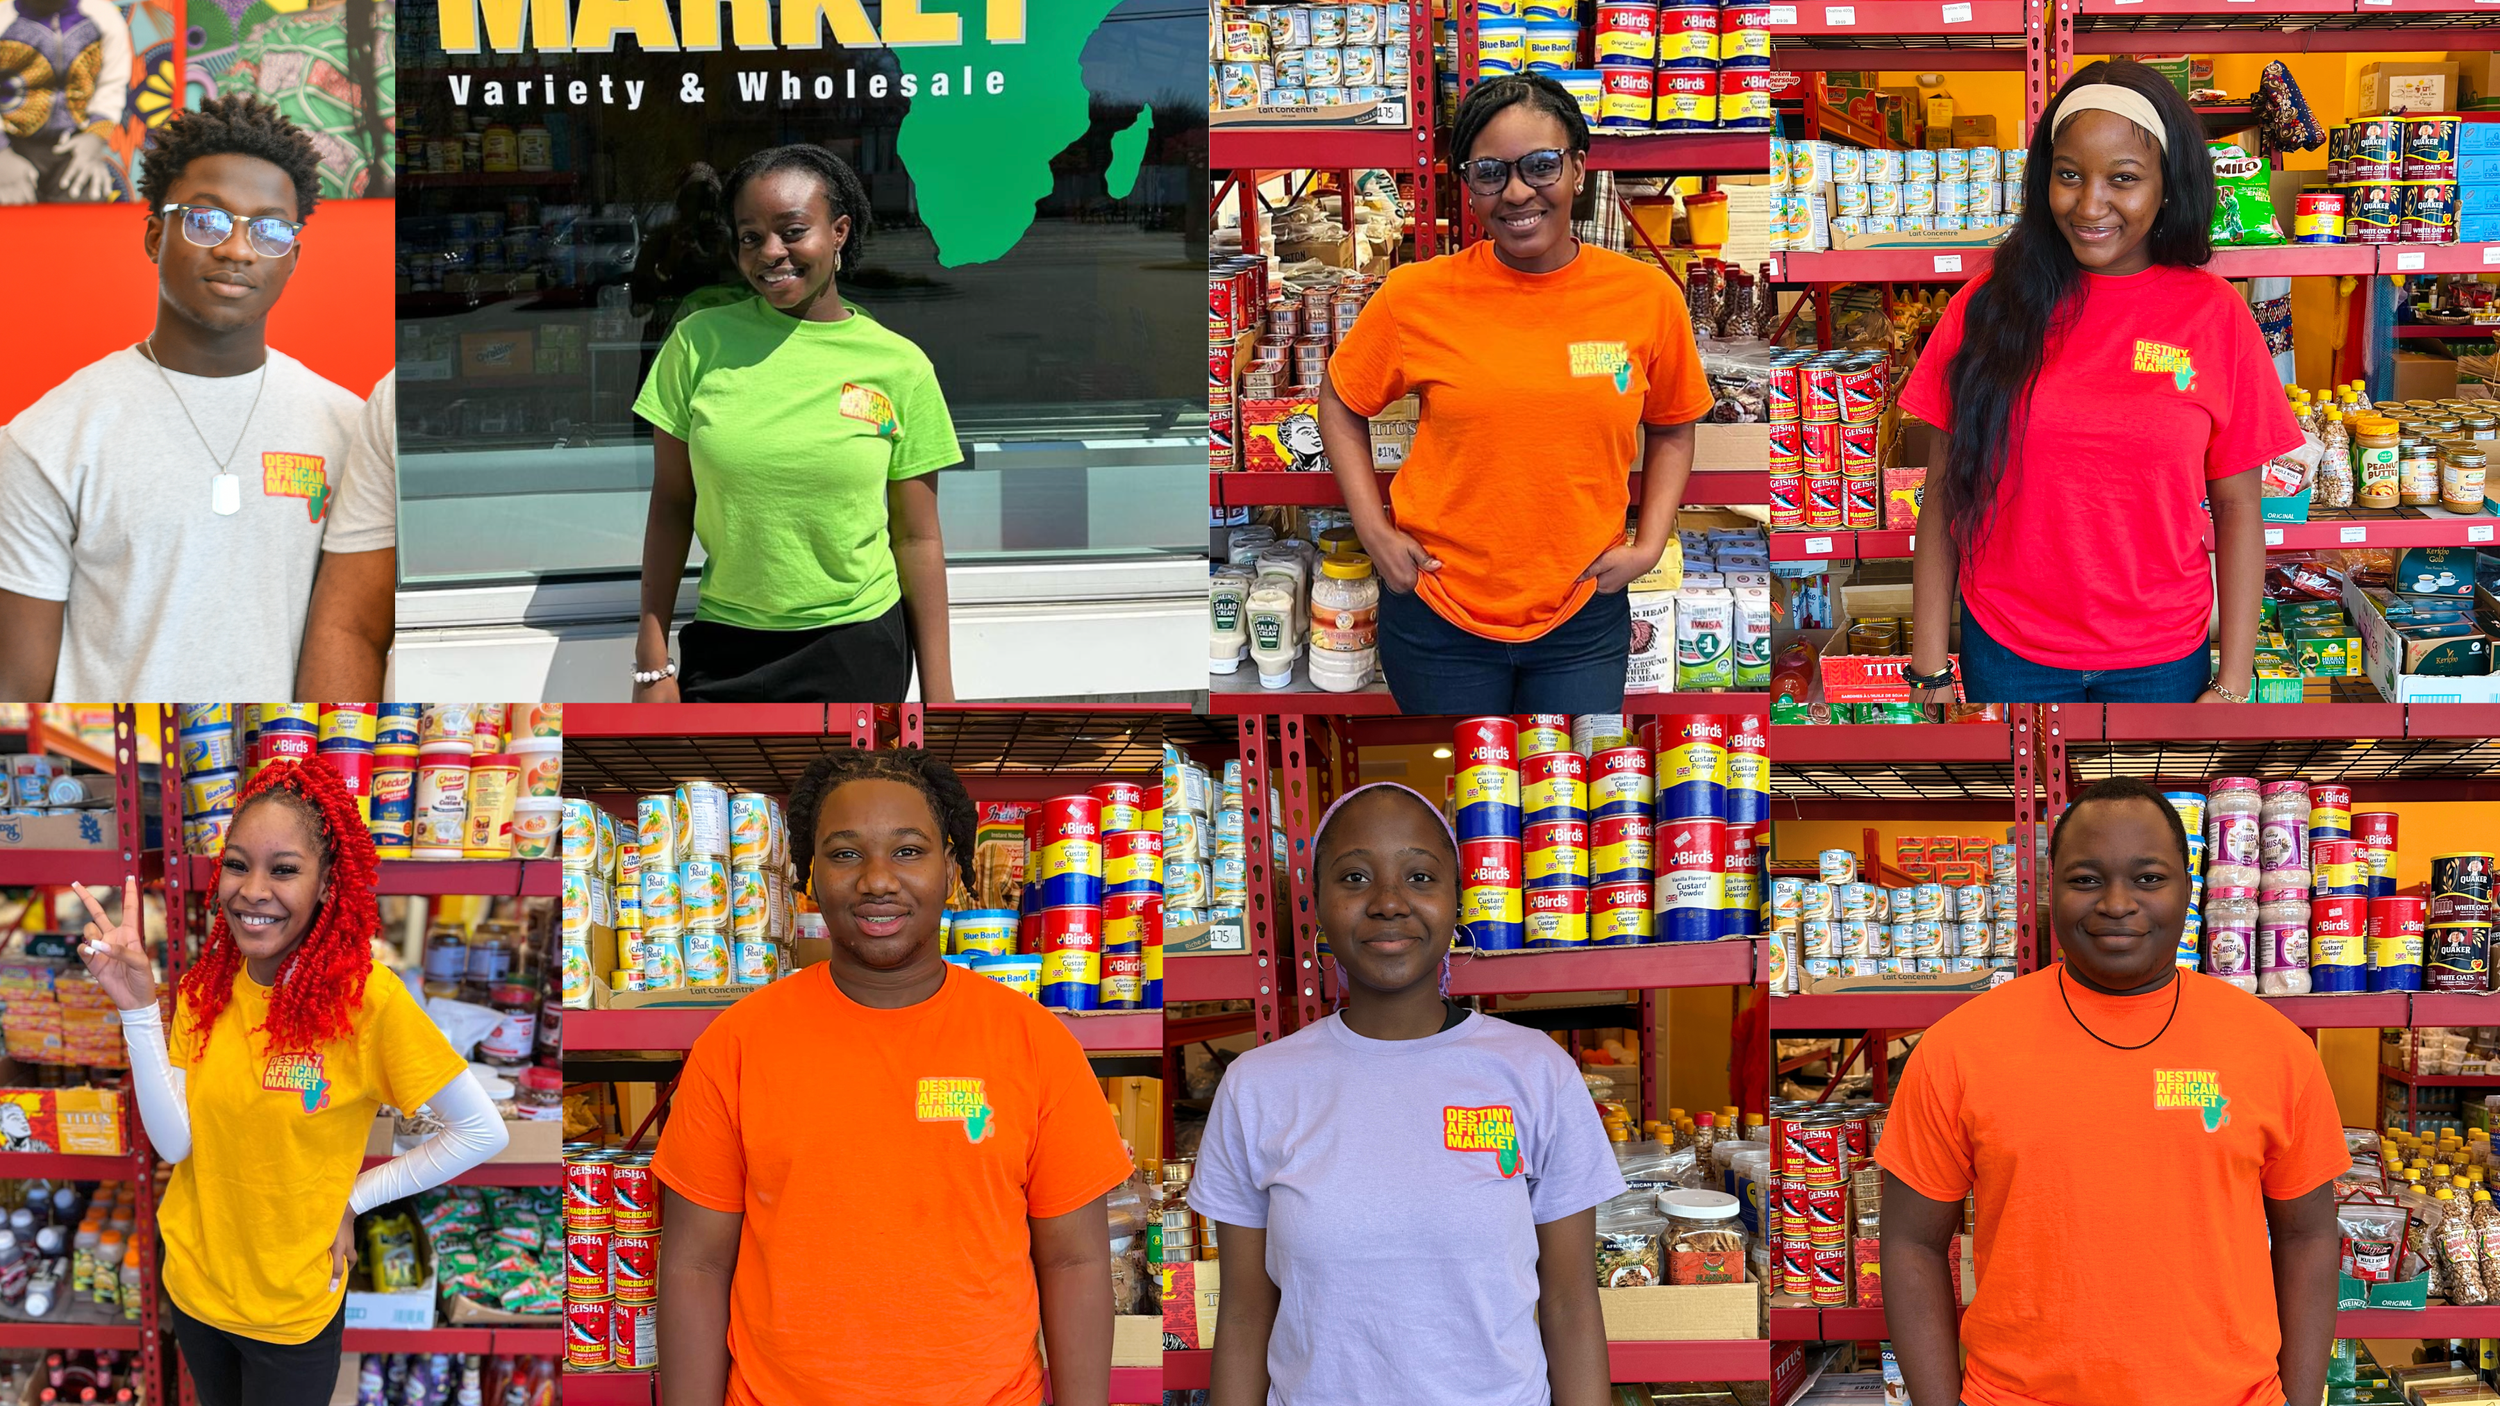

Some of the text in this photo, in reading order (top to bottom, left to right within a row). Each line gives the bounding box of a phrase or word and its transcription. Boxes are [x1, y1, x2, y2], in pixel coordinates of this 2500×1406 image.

[1621, 13, 1649, 28] Bird's
[1693, 15, 1716, 28] Bird's
[1479, 39, 1519, 50] Blue Band
[1531, 43, 1570, 52] Blue Band
[448, 65, 1006, 111] Variety & Wholesale
[1620, 75, 1649, 90] Bird's
[1676, 78, 1705, 91] Bird's
[2413, 138, 2438, 146] QUAKER
[2215, 161, 2258, 174] MILO
[2319, 201, 2340, 211] Bird's
[2364, 202, 2389, 210] QUAKER
[2418, 201, 2443, 209] QUAKER
[1569, 343, 1624, 355] DESTINY
[2135, 340, 2189, 357] DESTINY
[1570, 351, 1627, 364] AFRICAN
[2134, 351, 2191, 366] AFRICAN
[1572, 362, 1626, 374] MARKET
[2134, 361, 2188, 375] MARKET
[1845, 428, 1873, 437] GEISHA
[264, 454, 323, 470] DESTINY
[265, 467, 325, 484] AFRICAN
[266, 480, 322, 497] MARKET
[1770, 479, 1799, 488] GEISHA
[1811, 479, 1839, 488] GEISHA
[1215, 603, 1237, 611] SALAD
[1642, 605, 1669, 618] HEAD
[1257, 623, 1278, 632] SALAD
[1863, 662, 1909, 676] TITU
[1692, 723, 1722, 738] Bird's
[281, 739, 308, 753] Bird's
[1734, 734, 1765, 748] Bird's
[1479, 746, 1510, 760] Bird's
[1689, 755, 1718, 763] Custard
[1552, 760, 1581, 774] Bird's
[1614, 755, 1646, 769] Bird's
[1730, 764, 1759, 773] Custard
[1477, 777, 1505, 785] Custard
[1615, 780, 1638, 788] Custard
[1479, 784, 1503, 792] Powder
[1116, 790, 1140, 803] Bird's
[2325, 791, 2349, 804] Bird's
[1067, 822, 1095, 835] Bird's
[1555, 828, 1583, 842] Bird's
[2369, 834, 2392, 846] Bird's
[1137, 838, 1161, 851] Bird's
[1064, 850, 1089, 858] Custard
[1679, 850, 1714, 865] Bird's
[690, 863, 710, 877] Peak
[1479, 867, 1510, 881] Bird's
[647, 874, 665, 888] Peak
[1676, 882, 1707, 890] Custard
[2460, 875, 2487, 885] QUAKER
[1537, 894, 1568, 908] Bird's
[1616, 890, 1647, 904] Bird's
[2473, 904, 2489, 912] OATS
[2322, 920, 2349, 932] Bird's
[964, 931, 1000, 940] Blue Band
[1065, 933, 1093, 945] Bird's
[690, 938, 710, 951] Peak
[2441, 945, 2471, 955] QUAKER
[745, 945, 764, 957] Peak
[1007, 974, 1028, 982] Band
[2437, 974, 2457, 982] WHITE
[266, 1066, 321, 1079] AFRICAN
[2156, 1071, 2216, 1083] DESTINY
[265, 1076, 318, 1091] MARKET
[918, 1080, 982, 1093] DESTINY
[2156, 1083, 2219, 1095] AFRICAN
[918, 1092, 984, 1105] AFRICAN
[2157, 1094, 2218, 1107] MARKET
[918, 1104, 983, 1118] MARKET
[1446, 1108, 1512, 1123] DESTINY
[65, 1113, 112, 1125] TITUS
[1446, 1121, 1515, 1137] AFRICAN
[1803, 1131, 1832, 1140] GEISHA
[1447, 1134, 1514, 1150] MARKET
[570, 1166, 607, 1177] GEISHA
[613, 1169, 647, 1180] GEISHA
[1808, 1190, 1839, 1200] GEISHA
[568, 1235, 603, 1246] GEISHA
[615, 1238, 649, 1249] GEISHA
[569, 1304, 604, 1314] GEISHA
[2340, 1300, 2366, 1308] HEINZ
[2382, 1299, 2412, 1307] ORIGINAL
